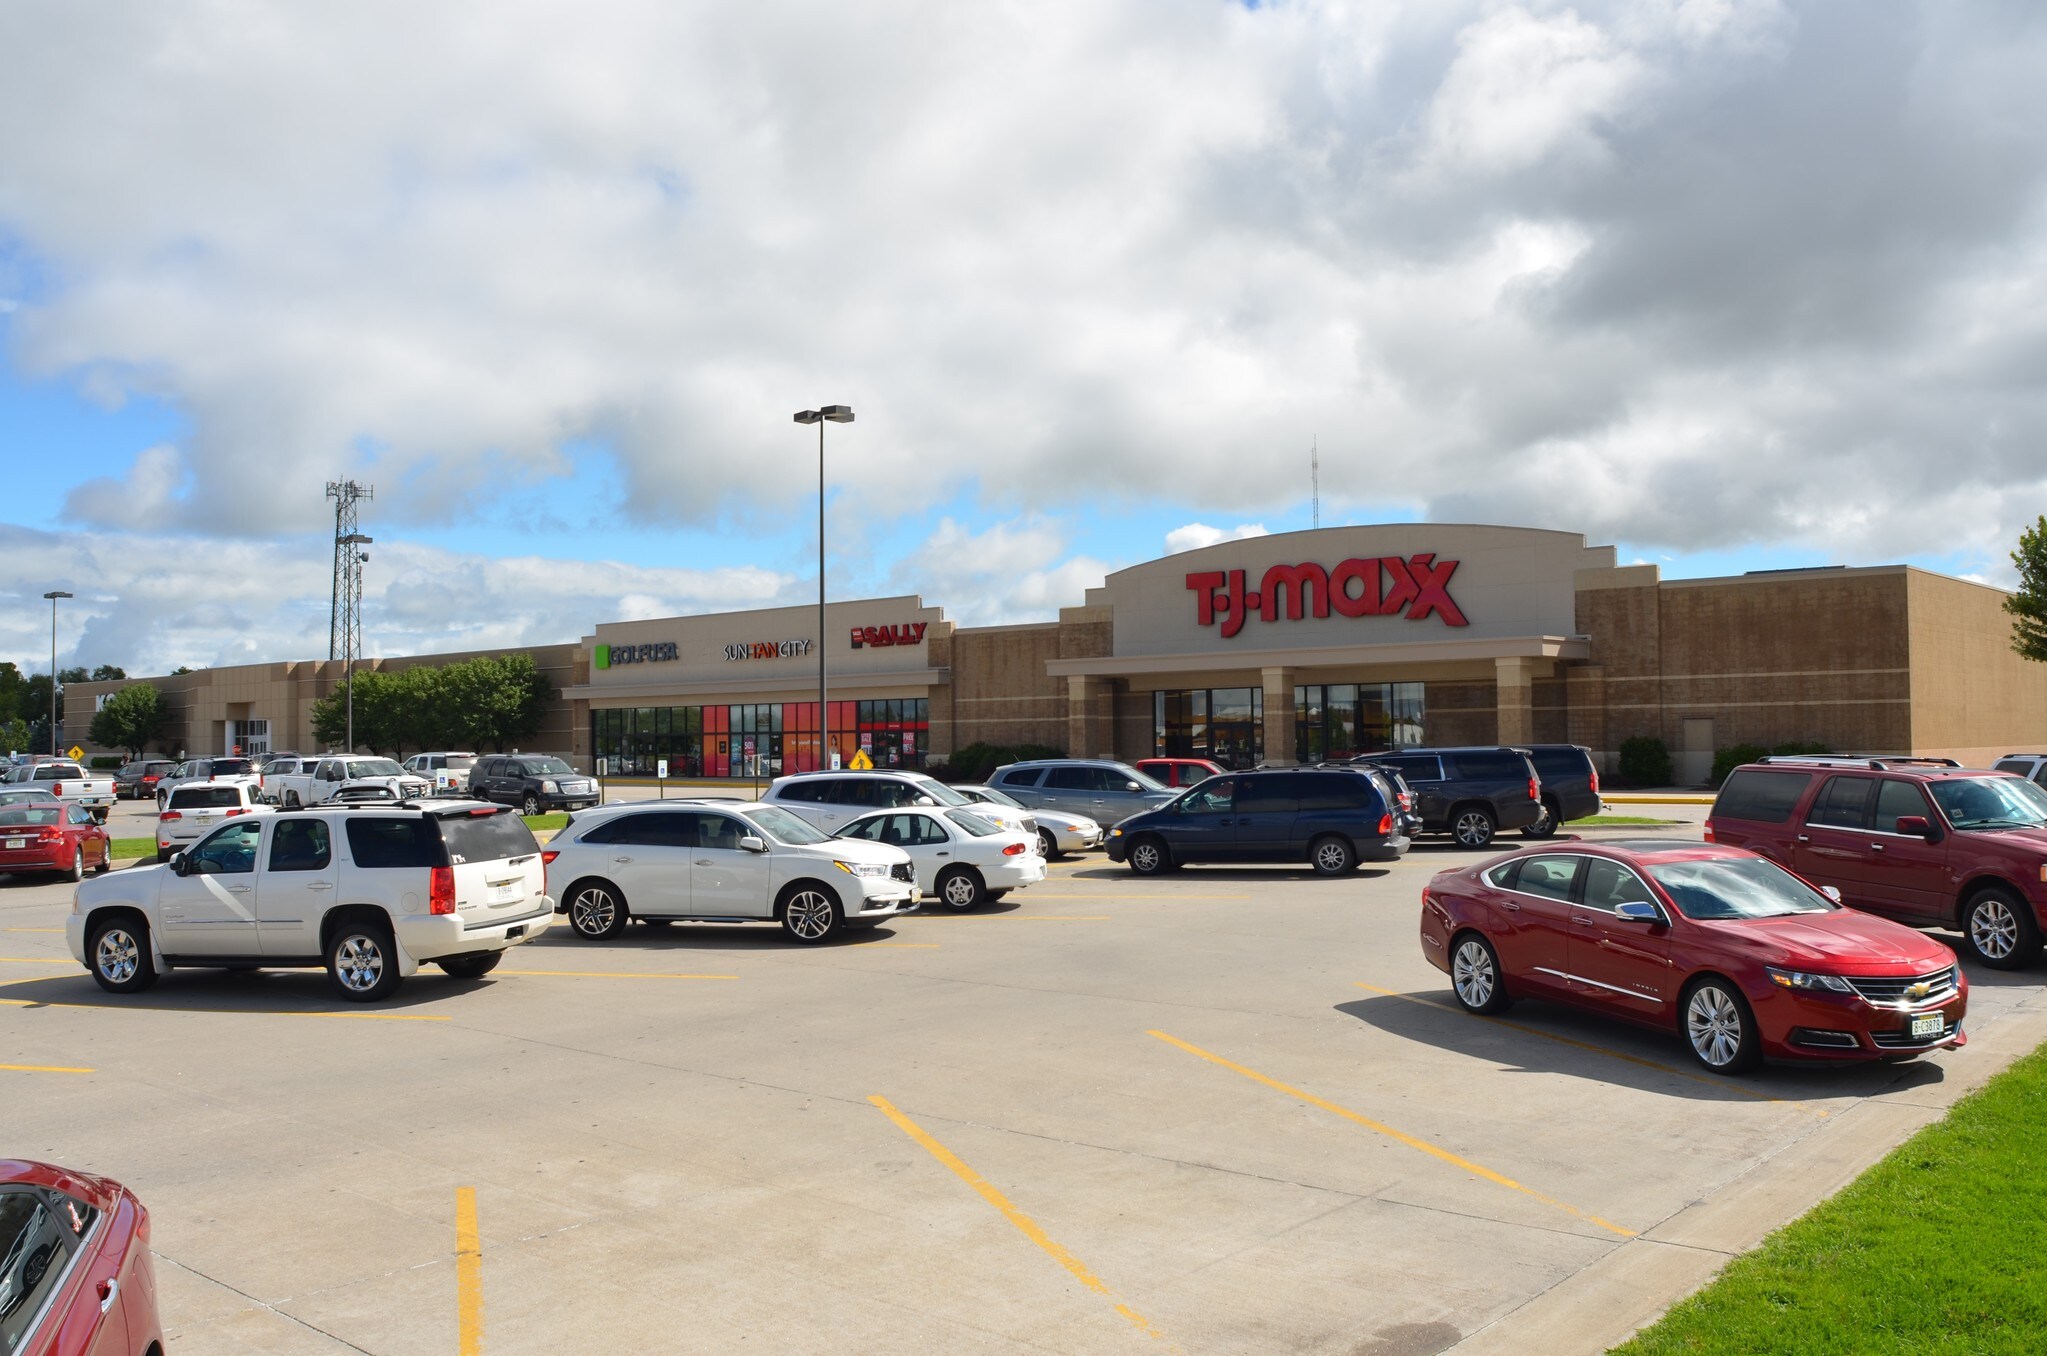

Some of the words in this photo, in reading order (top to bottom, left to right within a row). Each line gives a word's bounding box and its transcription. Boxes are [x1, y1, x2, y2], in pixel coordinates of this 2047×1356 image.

[864, 622, 928, 642] SALLY
[723, 644, 749, 661] SUN
[750, 642, 779, 659] TAN
[779, 639, 810, 657] CITY
